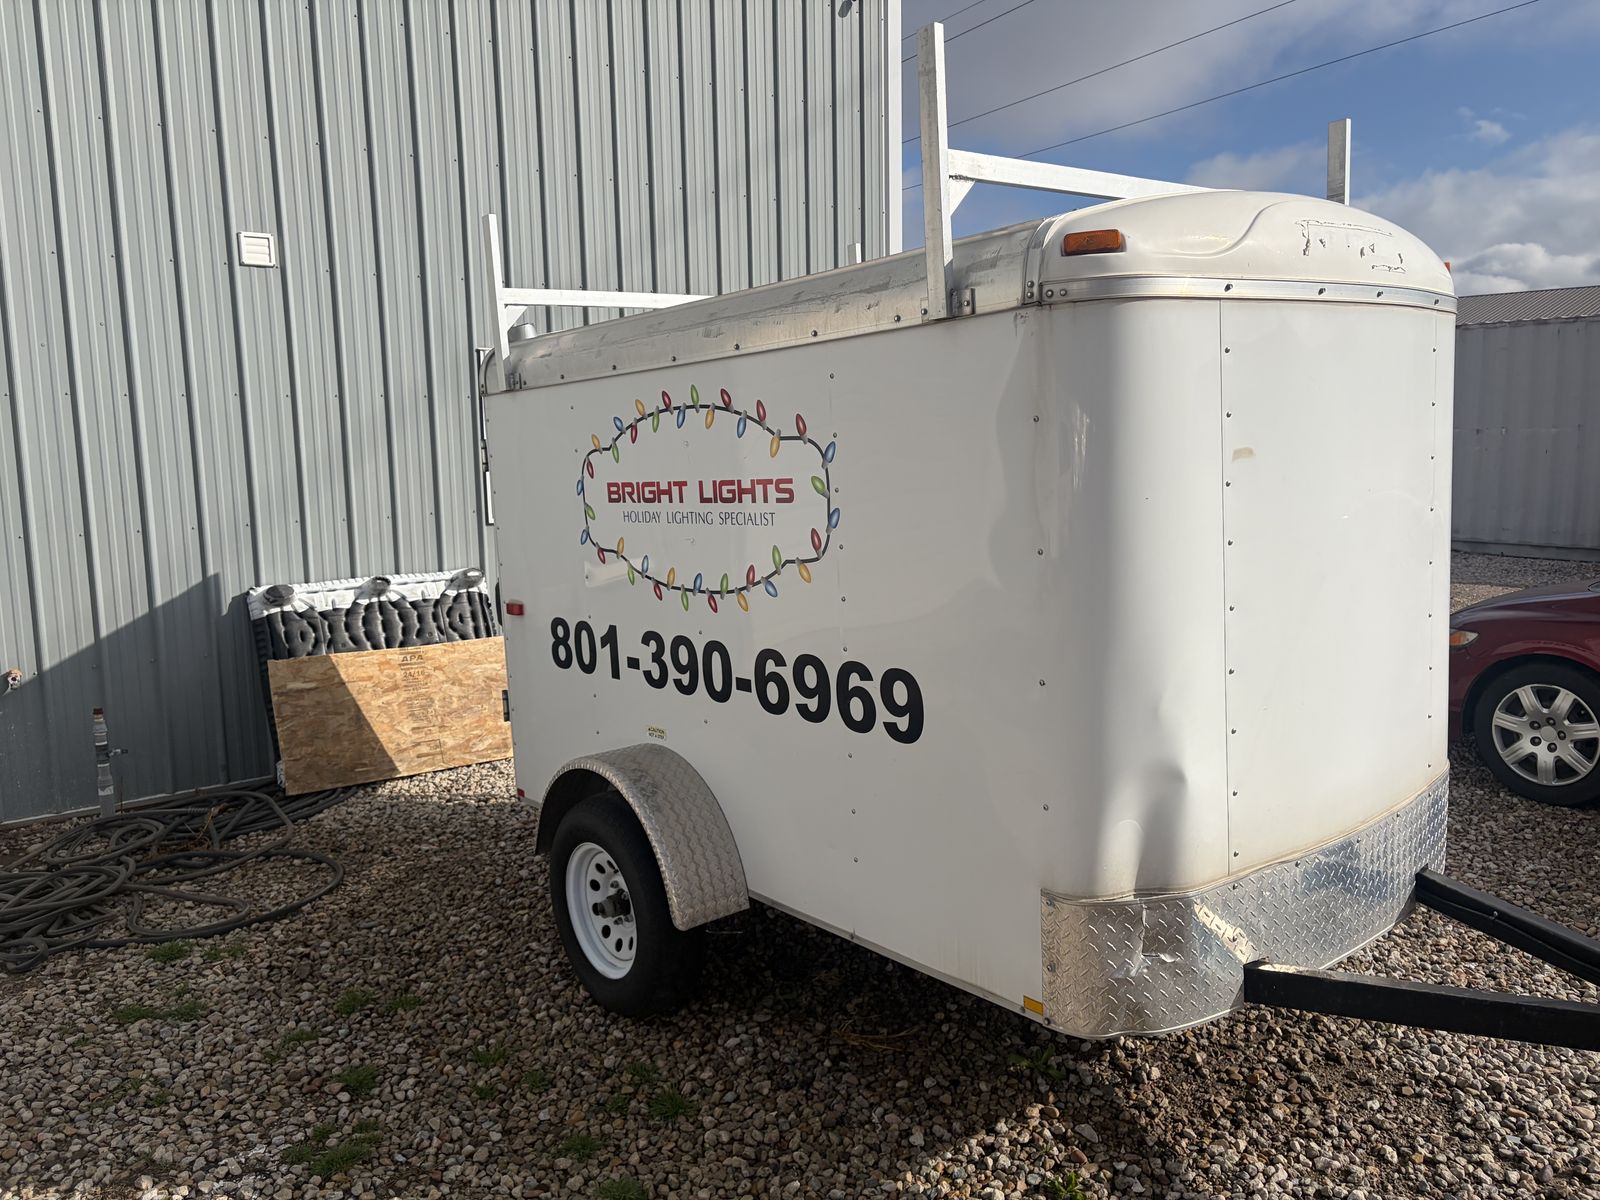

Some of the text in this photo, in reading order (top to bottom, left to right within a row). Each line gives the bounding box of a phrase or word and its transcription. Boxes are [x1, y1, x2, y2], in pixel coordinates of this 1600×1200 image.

[607, 478, 795, 504] BRIGHT LIGHTS
[623, 510, 776, 527] HOLIDAY LIGHTING SPECIALIST
[401, 654, 424, 663] APA
[550, 616, 925, 744] 801-390-6969
